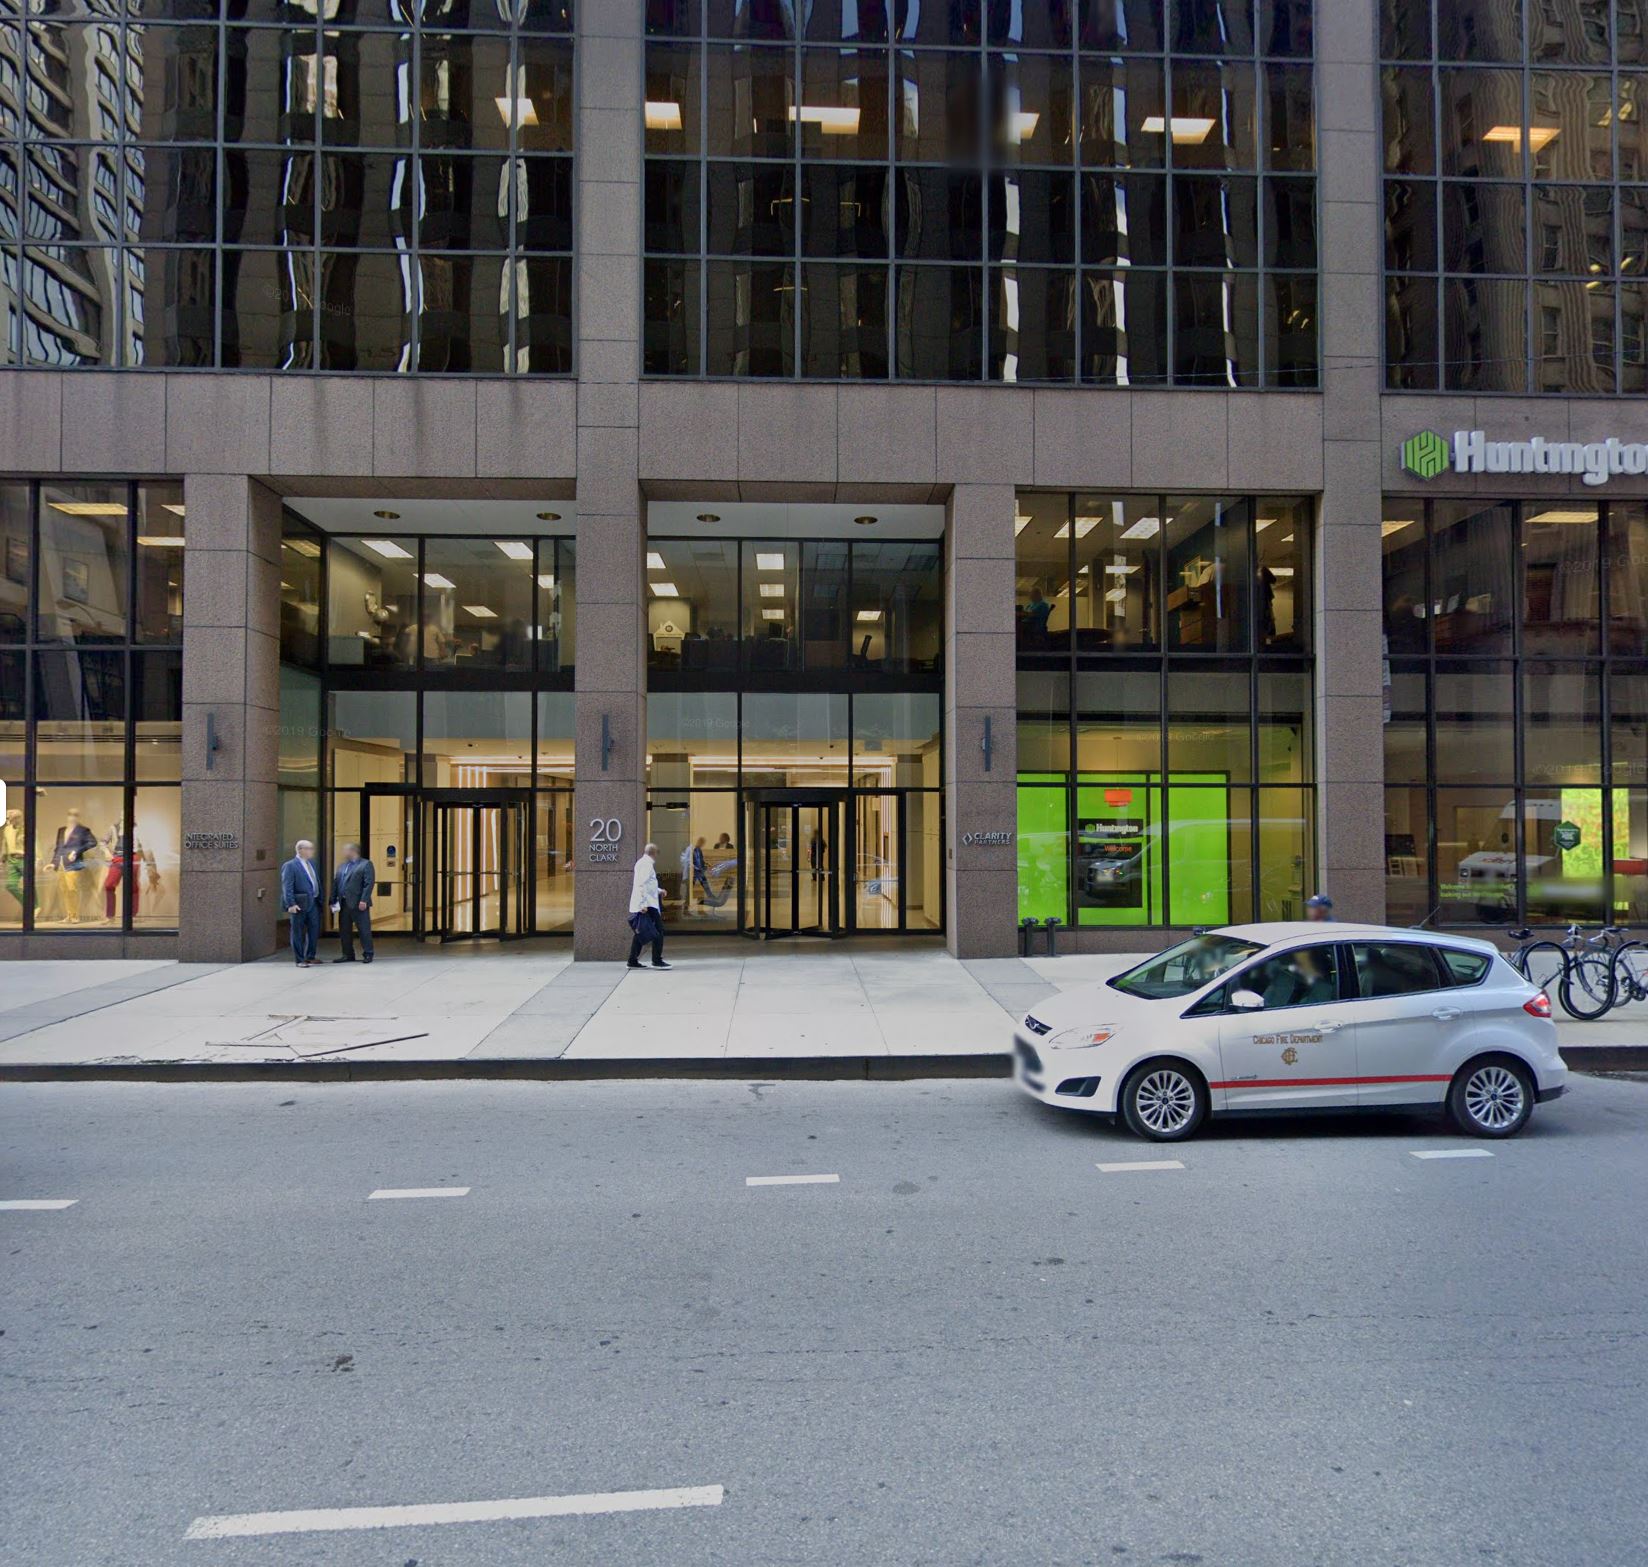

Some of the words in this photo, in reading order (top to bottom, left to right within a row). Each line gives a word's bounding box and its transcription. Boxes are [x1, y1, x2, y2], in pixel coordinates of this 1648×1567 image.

[1454, 430, 1648, 486] Huntingto
[590, 818, 622, 842] 20
[974, 832, 1012, 841] CLARITY
[185, 840, 213, 849] OFFICE
[590, 843, 618, 851] NORTH
[590, 853, 618, 862] CLARK
